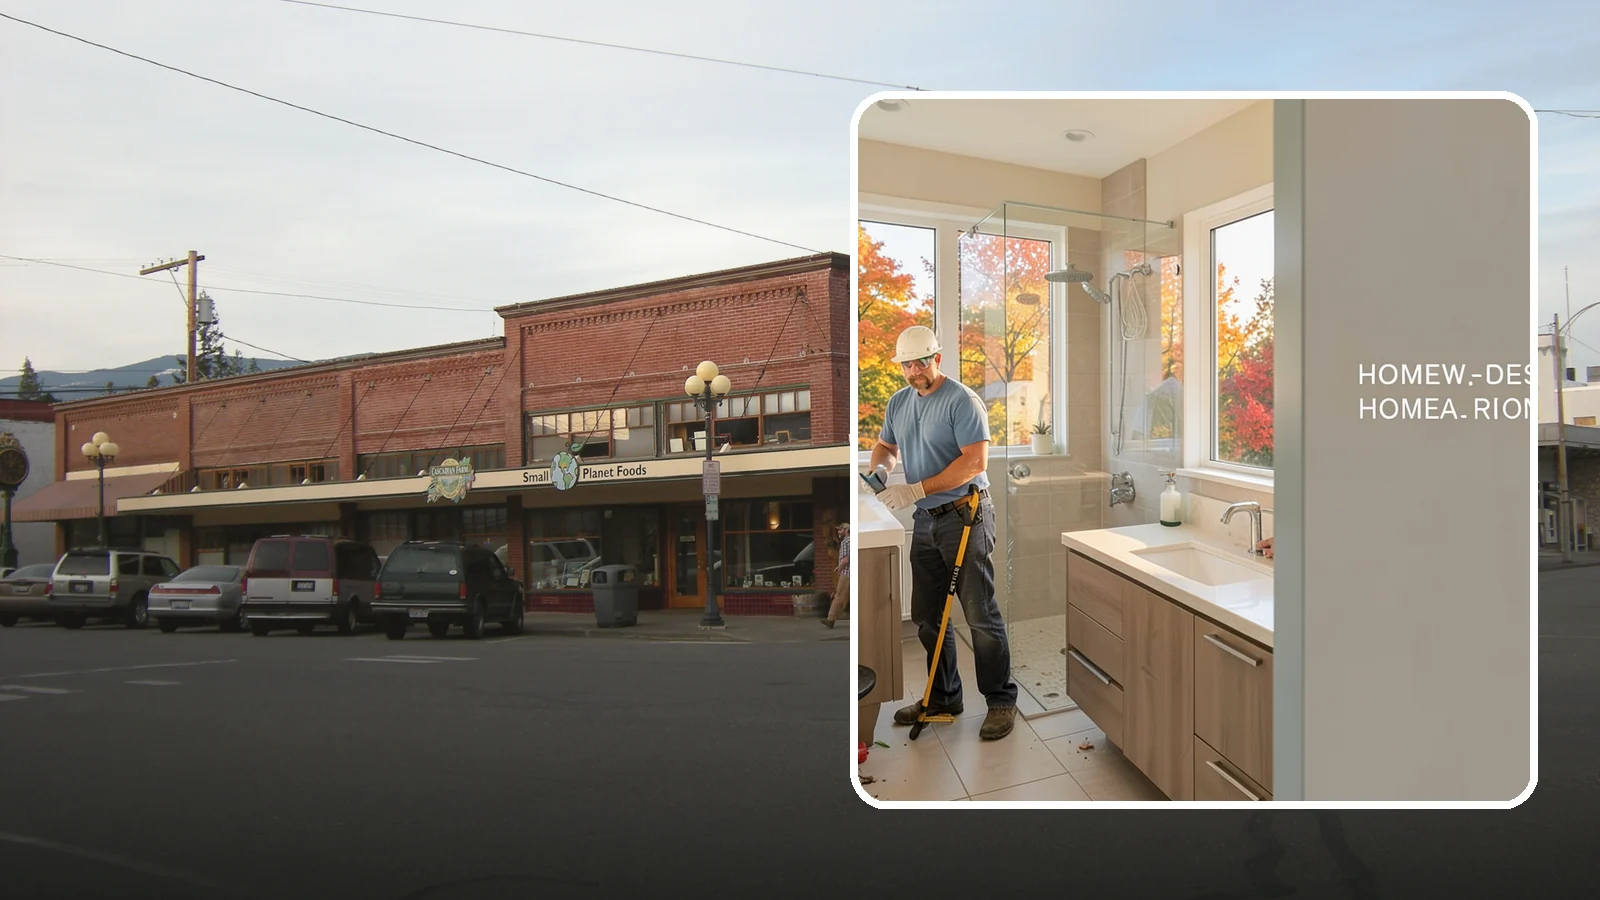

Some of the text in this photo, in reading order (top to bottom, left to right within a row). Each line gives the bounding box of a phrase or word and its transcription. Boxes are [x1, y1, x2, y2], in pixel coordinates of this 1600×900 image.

[522, 464, 647, 483] Small Planet Foods
